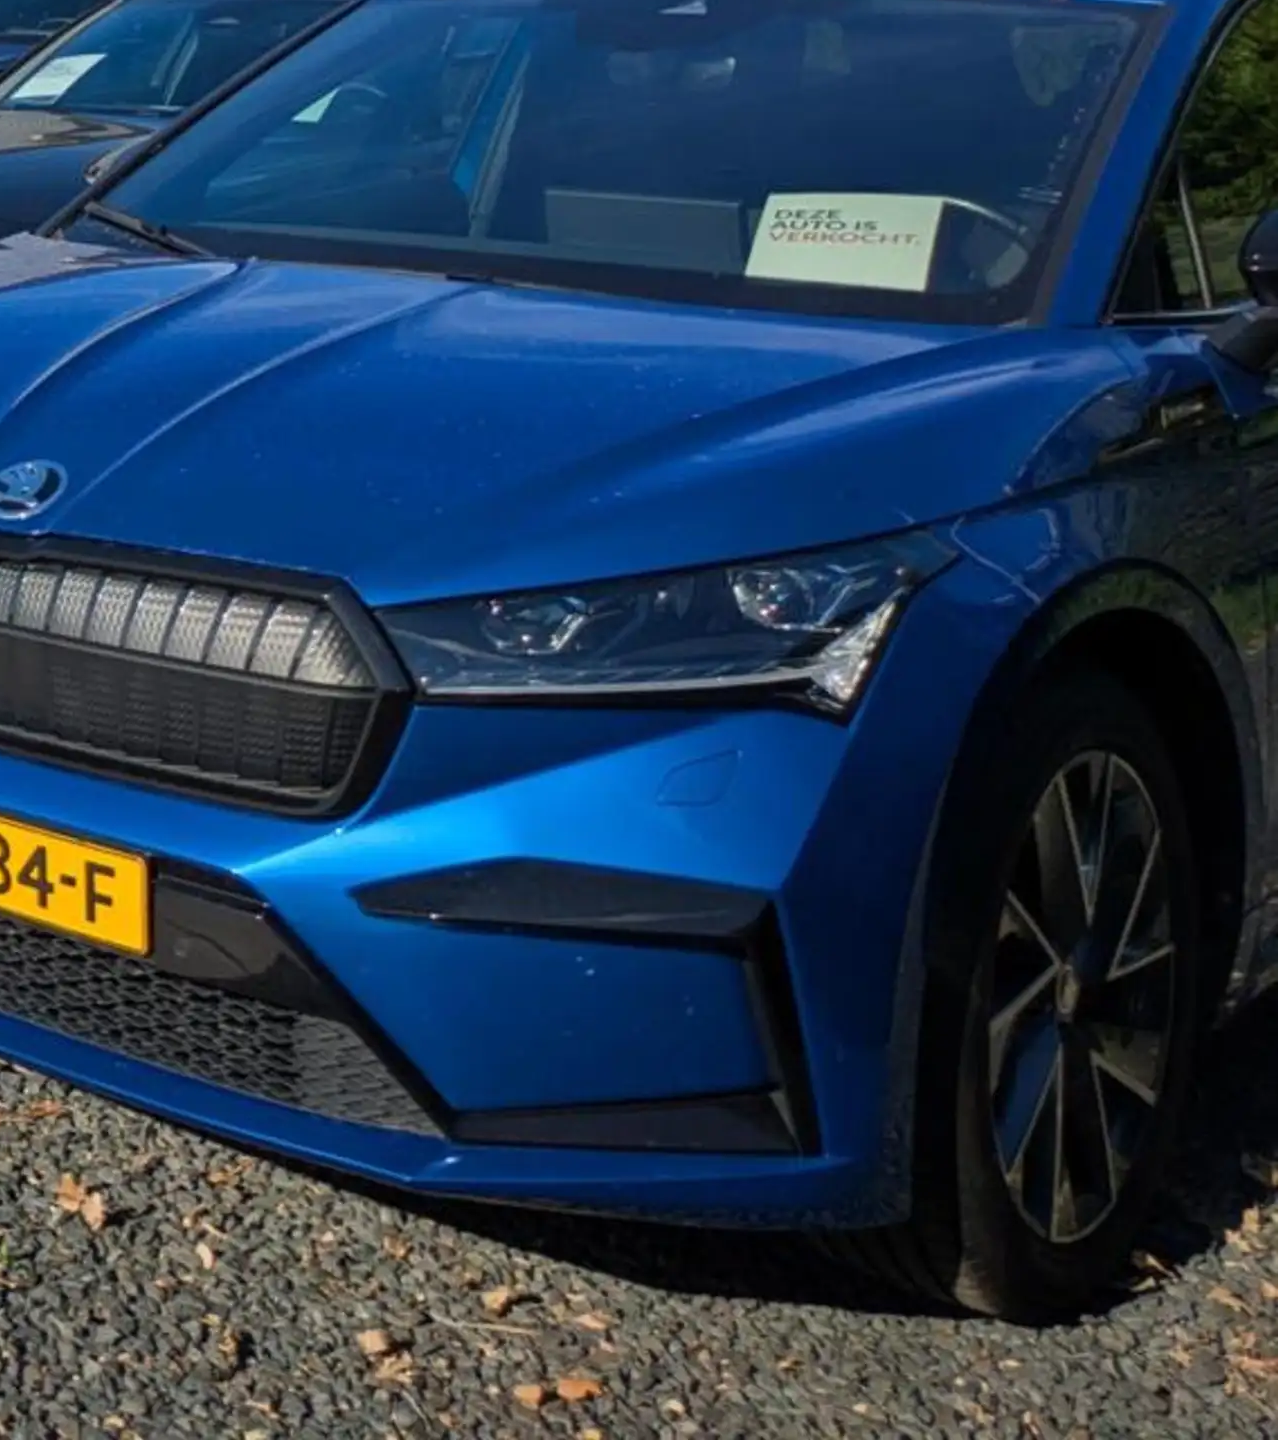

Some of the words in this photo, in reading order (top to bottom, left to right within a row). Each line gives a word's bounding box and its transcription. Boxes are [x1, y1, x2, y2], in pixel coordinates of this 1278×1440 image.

[774, 209, 842, 220] DEZE
[770, 220, 847, 231] AUTO
[855, 220, 879, 231] IS
